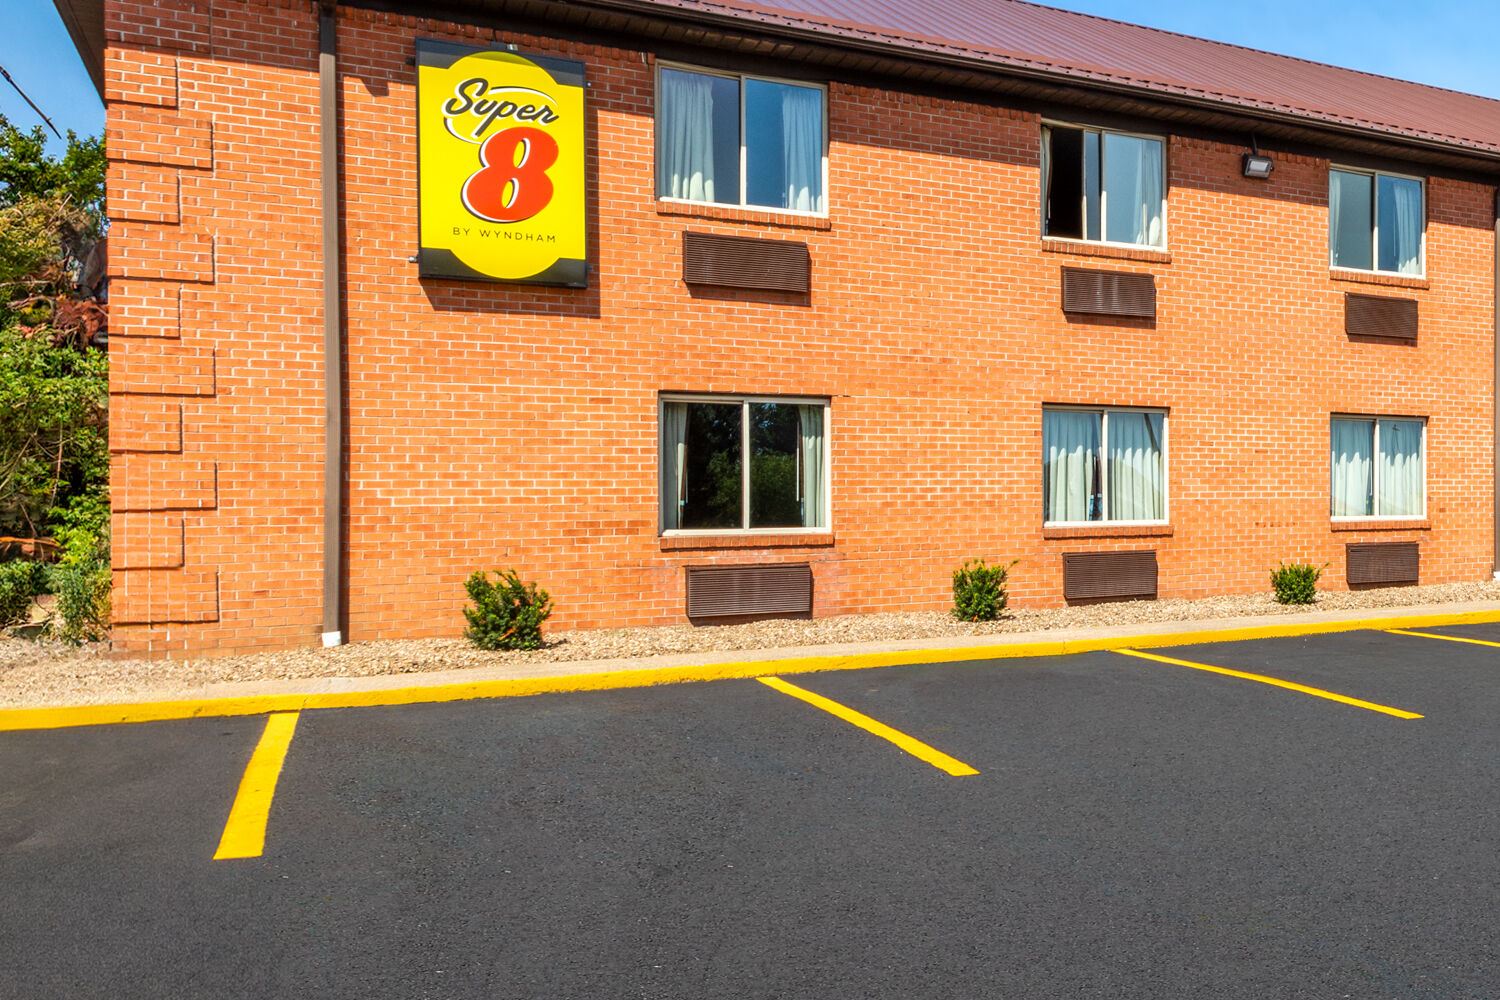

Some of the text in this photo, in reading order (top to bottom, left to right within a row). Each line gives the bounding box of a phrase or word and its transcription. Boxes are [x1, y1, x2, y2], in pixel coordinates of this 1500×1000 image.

[442, 78, 560, 139] Super
[461, 126, 559, 224] 8
[452, 227, 556, 243] BY WYNDHAM
